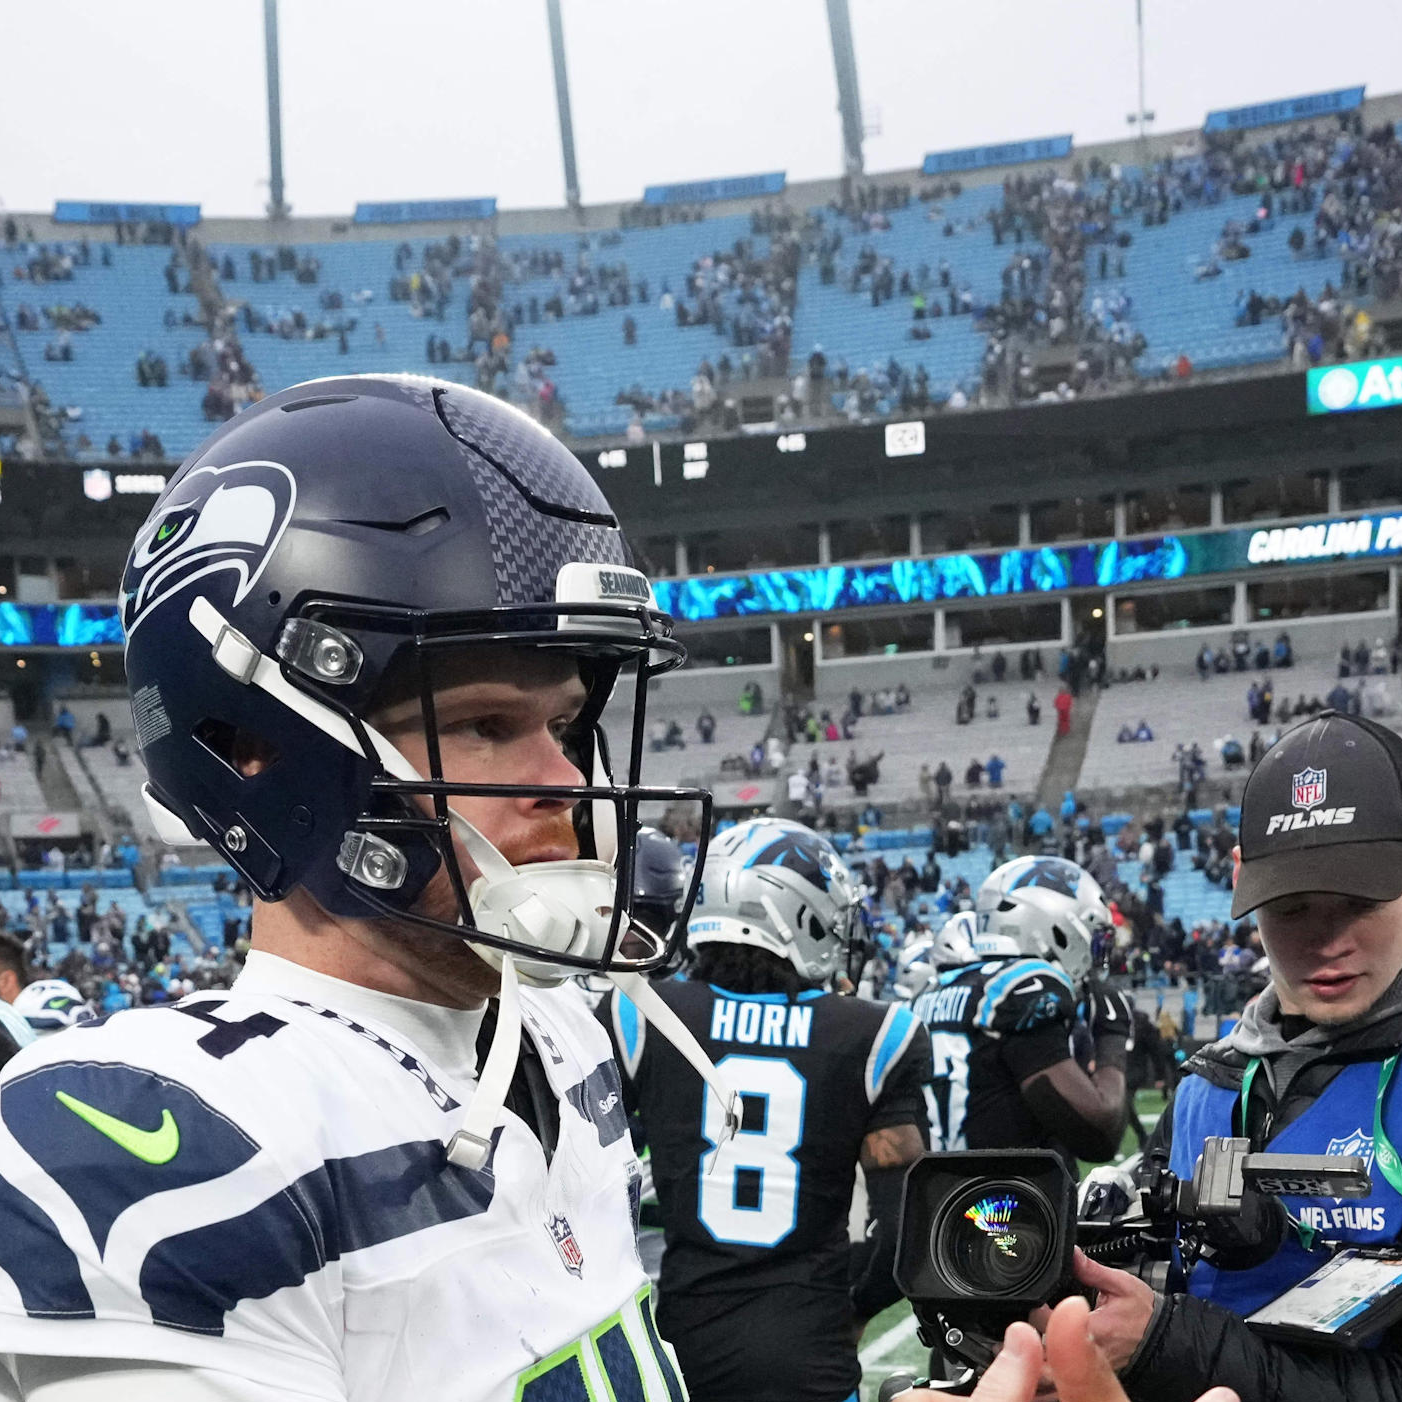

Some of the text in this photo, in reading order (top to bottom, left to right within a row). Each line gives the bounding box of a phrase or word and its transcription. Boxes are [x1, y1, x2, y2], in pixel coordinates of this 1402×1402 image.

[1247, 517, 1372, 564] CAROLINA
[1295, 784, 1322, 804] NFL
[1266, 807, 1357, 836] FILMS
[710, 998, 814, 1049] HORN
[697, 1053, 808, 1249] 8
[1298, 1207, 1386, 1231] NFL FILMS
